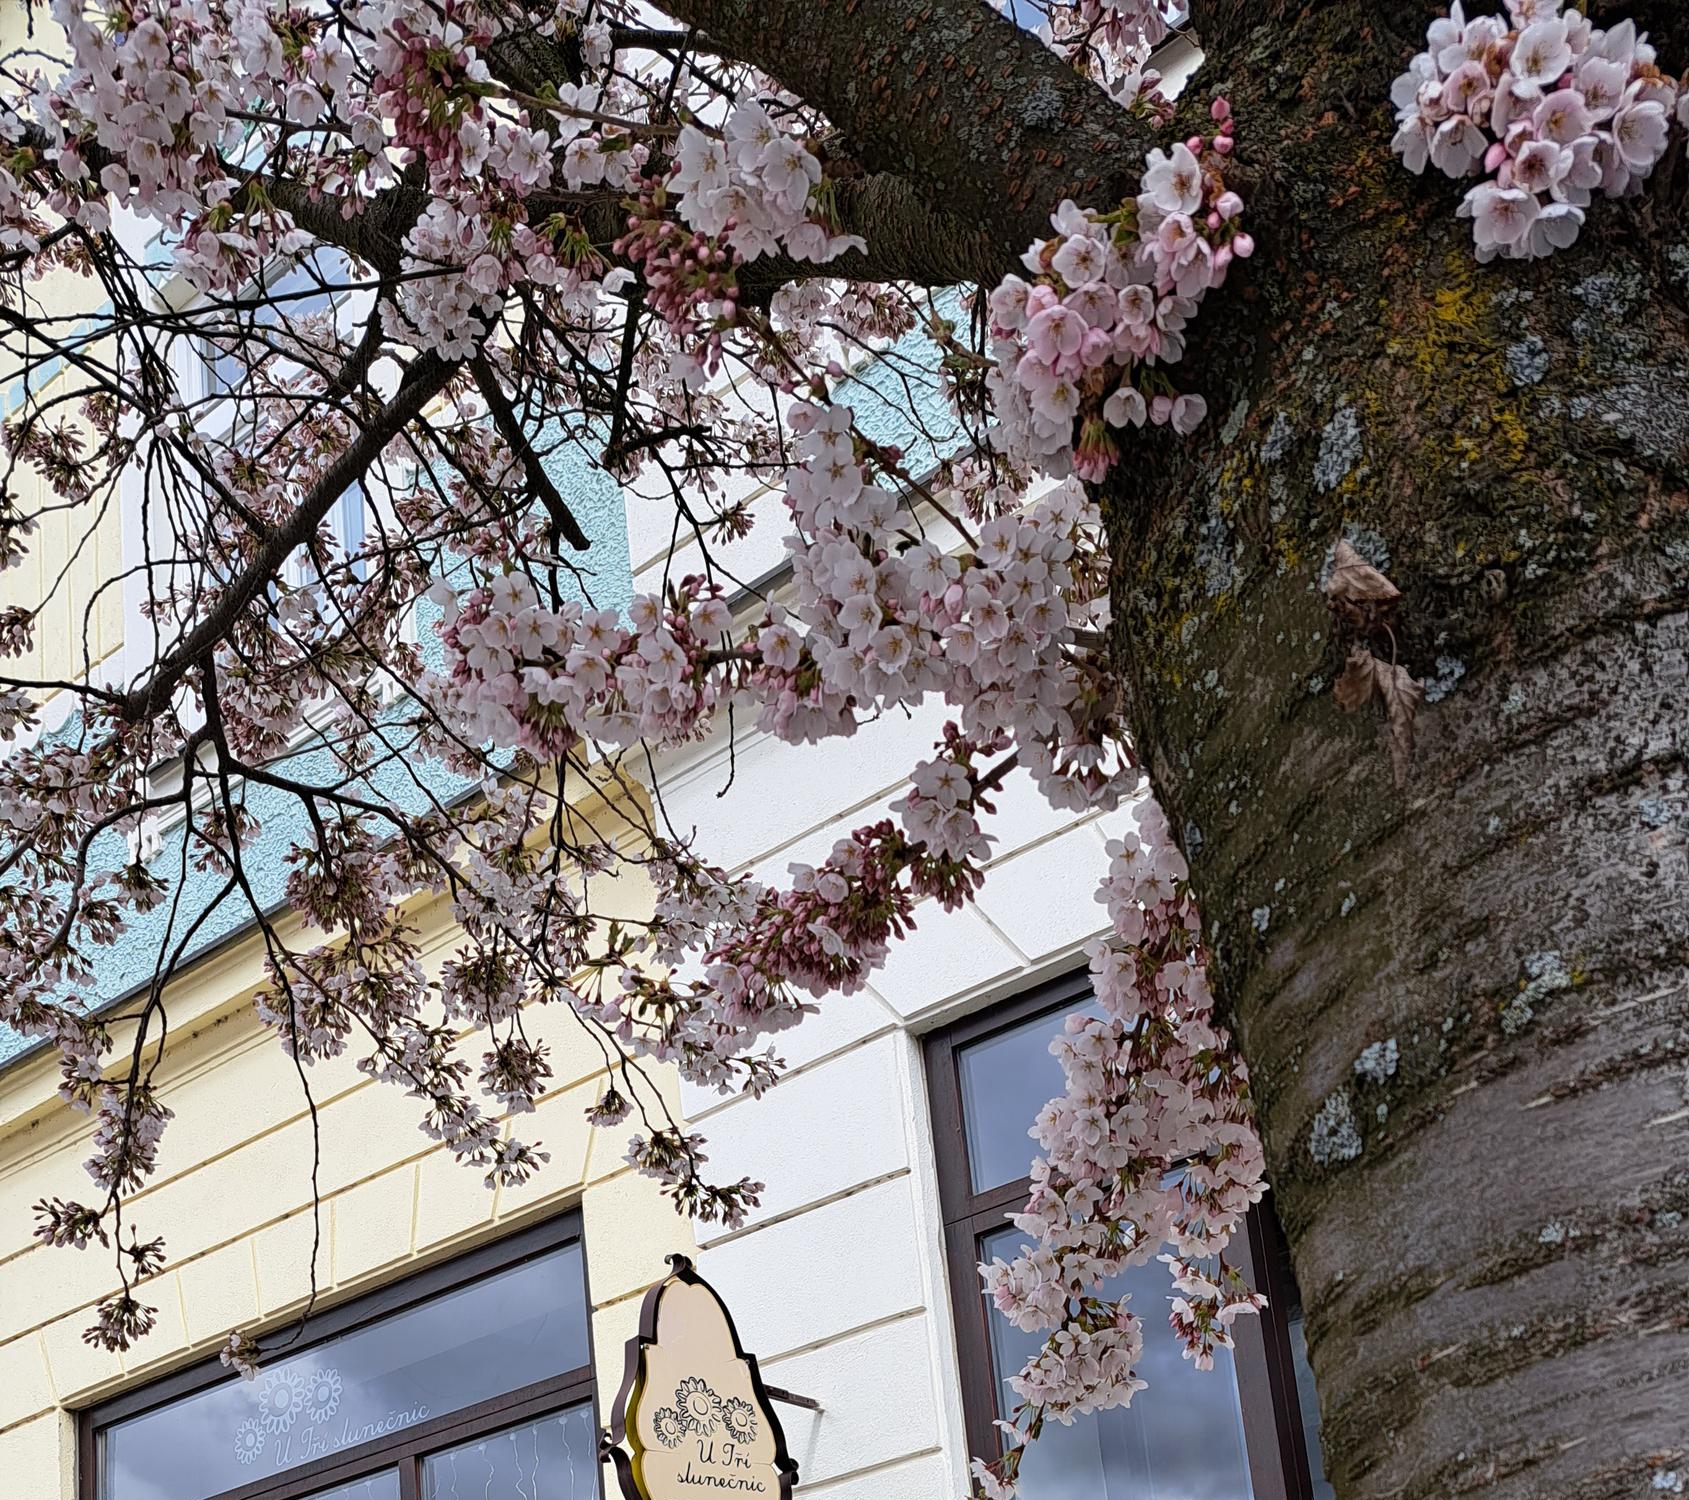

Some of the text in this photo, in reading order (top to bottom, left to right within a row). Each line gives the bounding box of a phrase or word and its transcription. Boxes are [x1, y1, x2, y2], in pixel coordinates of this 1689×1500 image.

[274, 1436, 292, 1466] U
[333, 1400, 431, 1448] slunečnic
[697, 1439, 716, 1464] U
[677, 1461, 766, 1492] slunečnic
